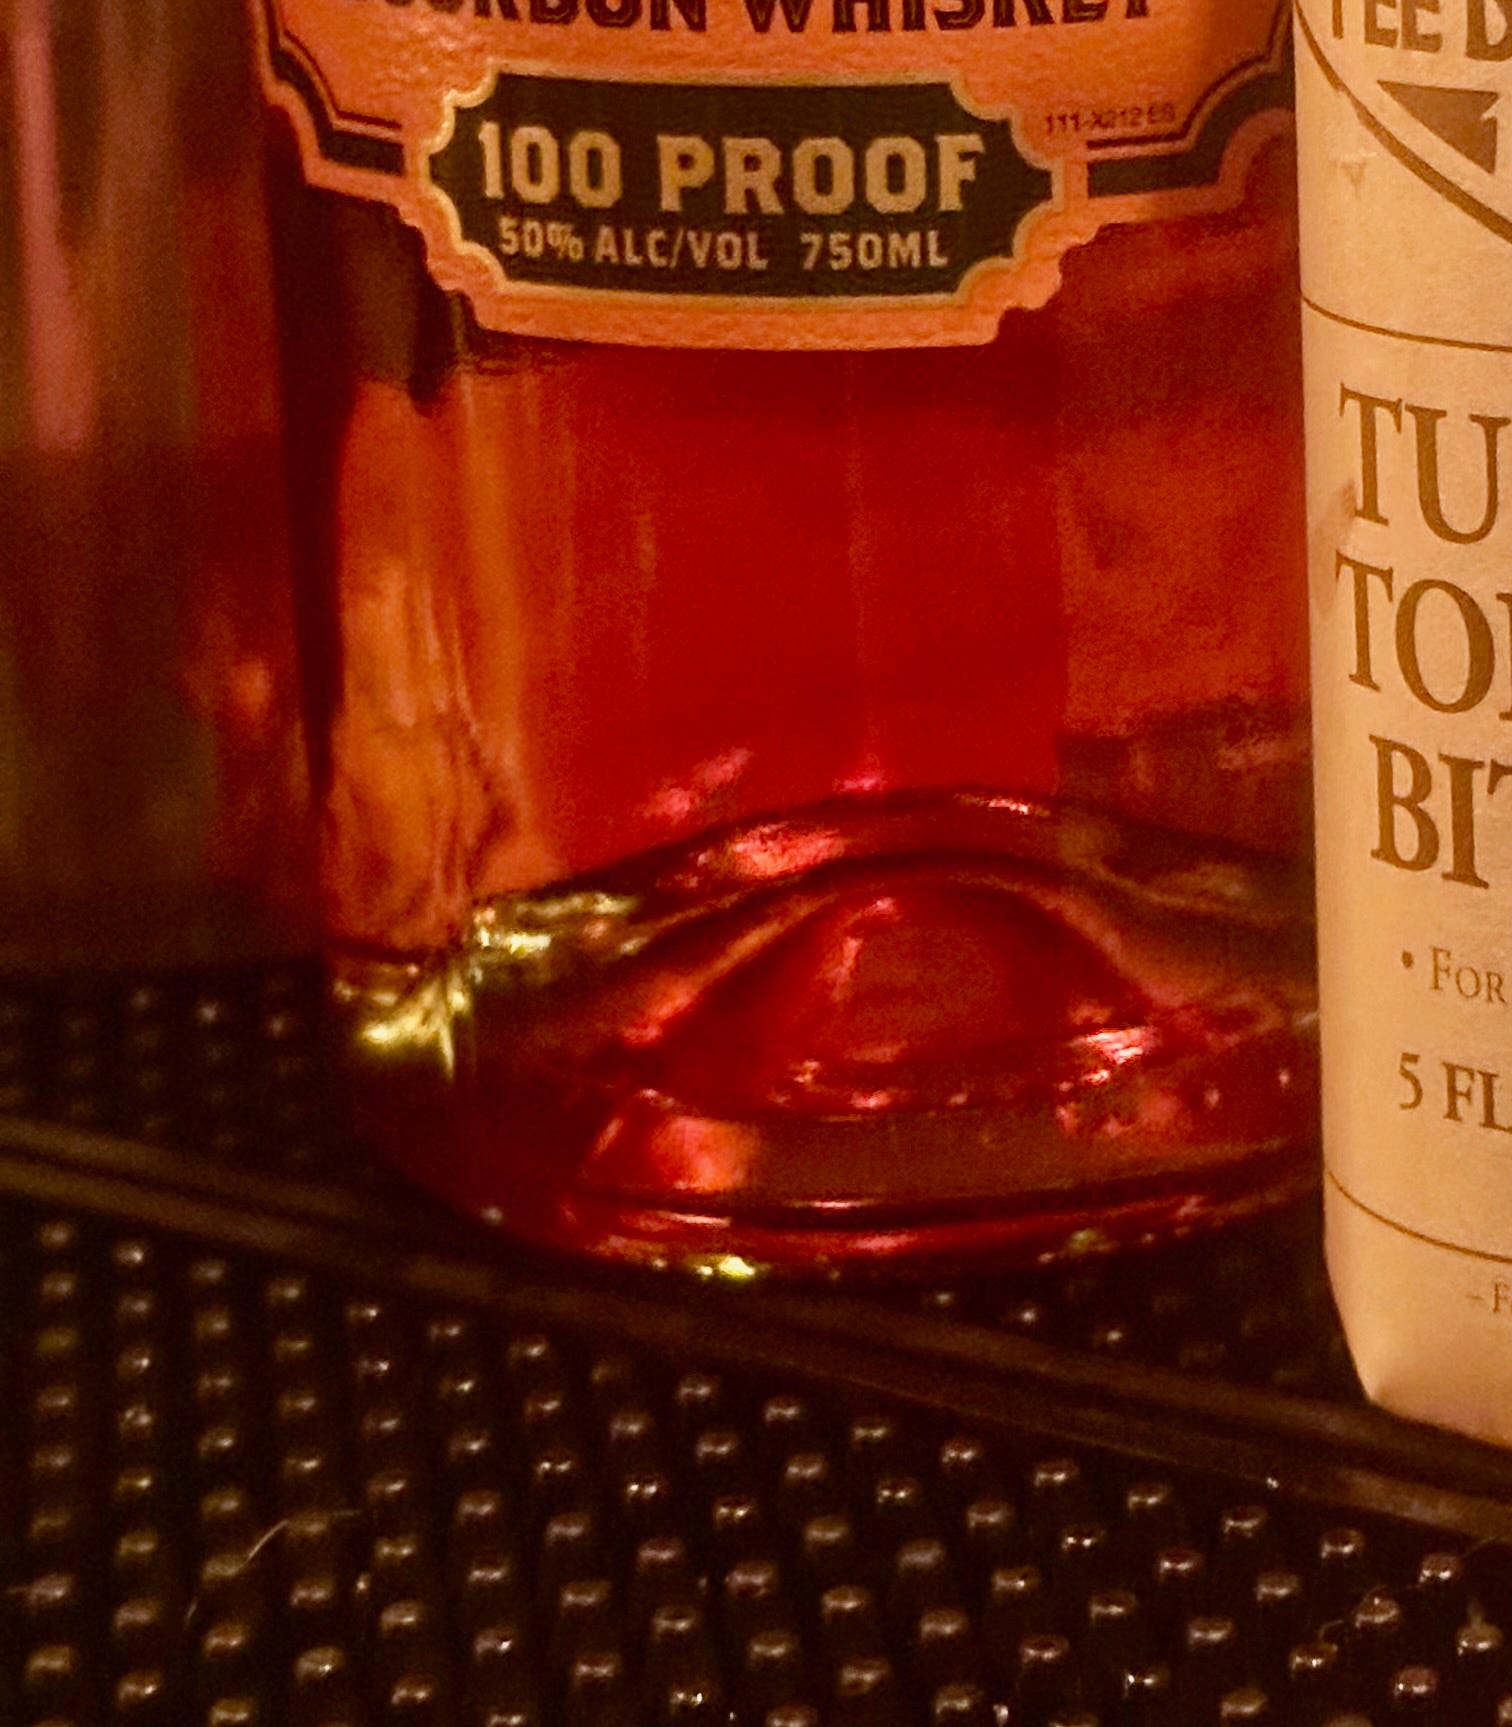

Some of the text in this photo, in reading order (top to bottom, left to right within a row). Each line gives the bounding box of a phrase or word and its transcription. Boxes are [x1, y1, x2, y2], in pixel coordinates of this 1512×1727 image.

[478, 120, 985, 216] 100 PROOF
[498, 216, 950, 272] 50% ALC/VOL 750ML
[1397, 1052, 1425, 1111] 5
